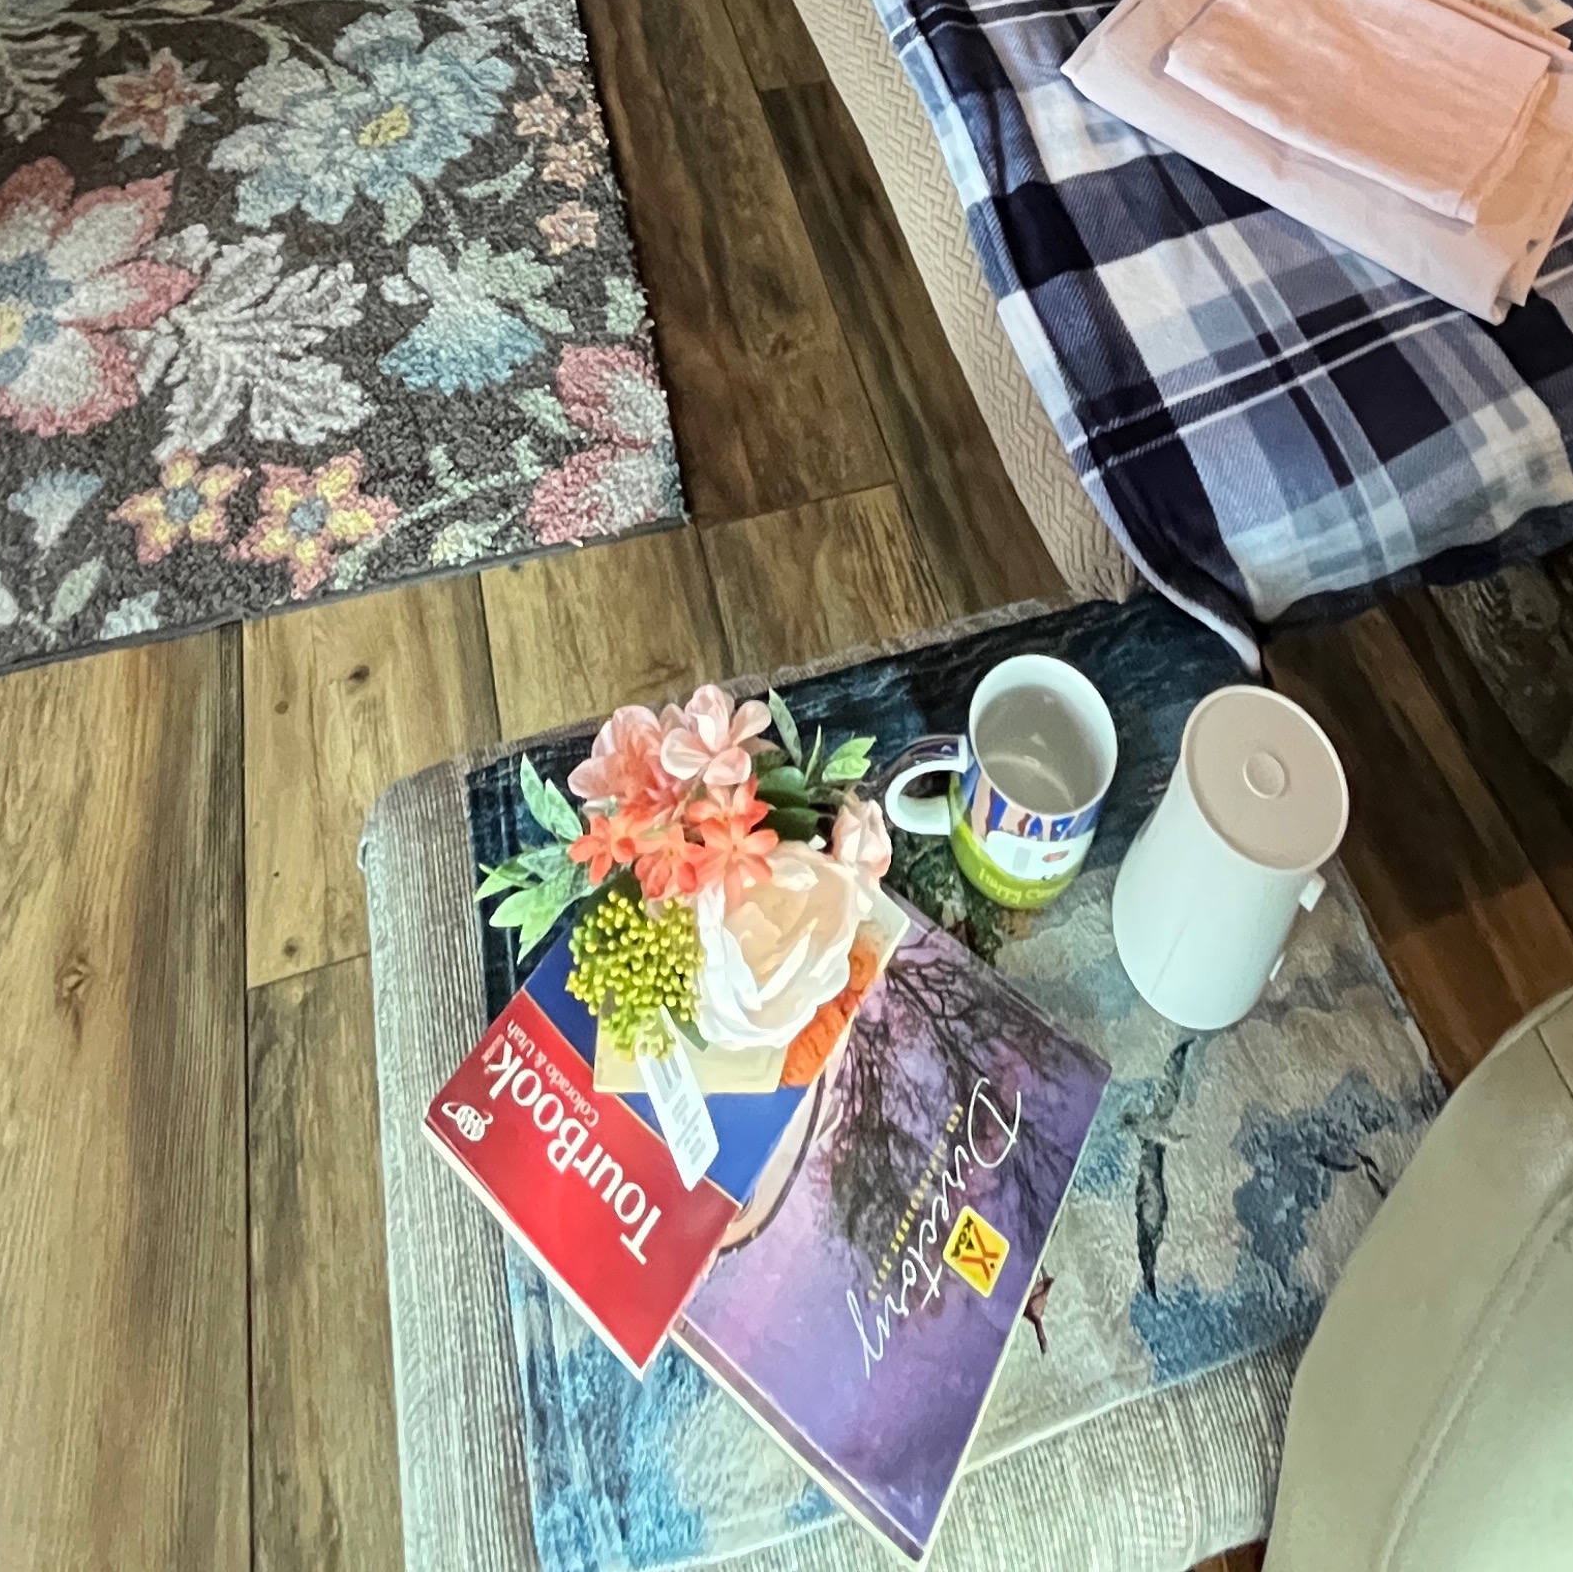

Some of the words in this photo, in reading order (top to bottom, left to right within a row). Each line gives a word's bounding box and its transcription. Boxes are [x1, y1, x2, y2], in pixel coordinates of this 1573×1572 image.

[507, 1019, 536, 1058] Utah
[534, 1051, 548, 1068] &
[545, 1063, 599, 1127] Colorado
[488, 1040, 662, 1265] TourBook
[846, 1077, 1022, 1380] Directory
[951, 1215, 975, 1258] KOA
